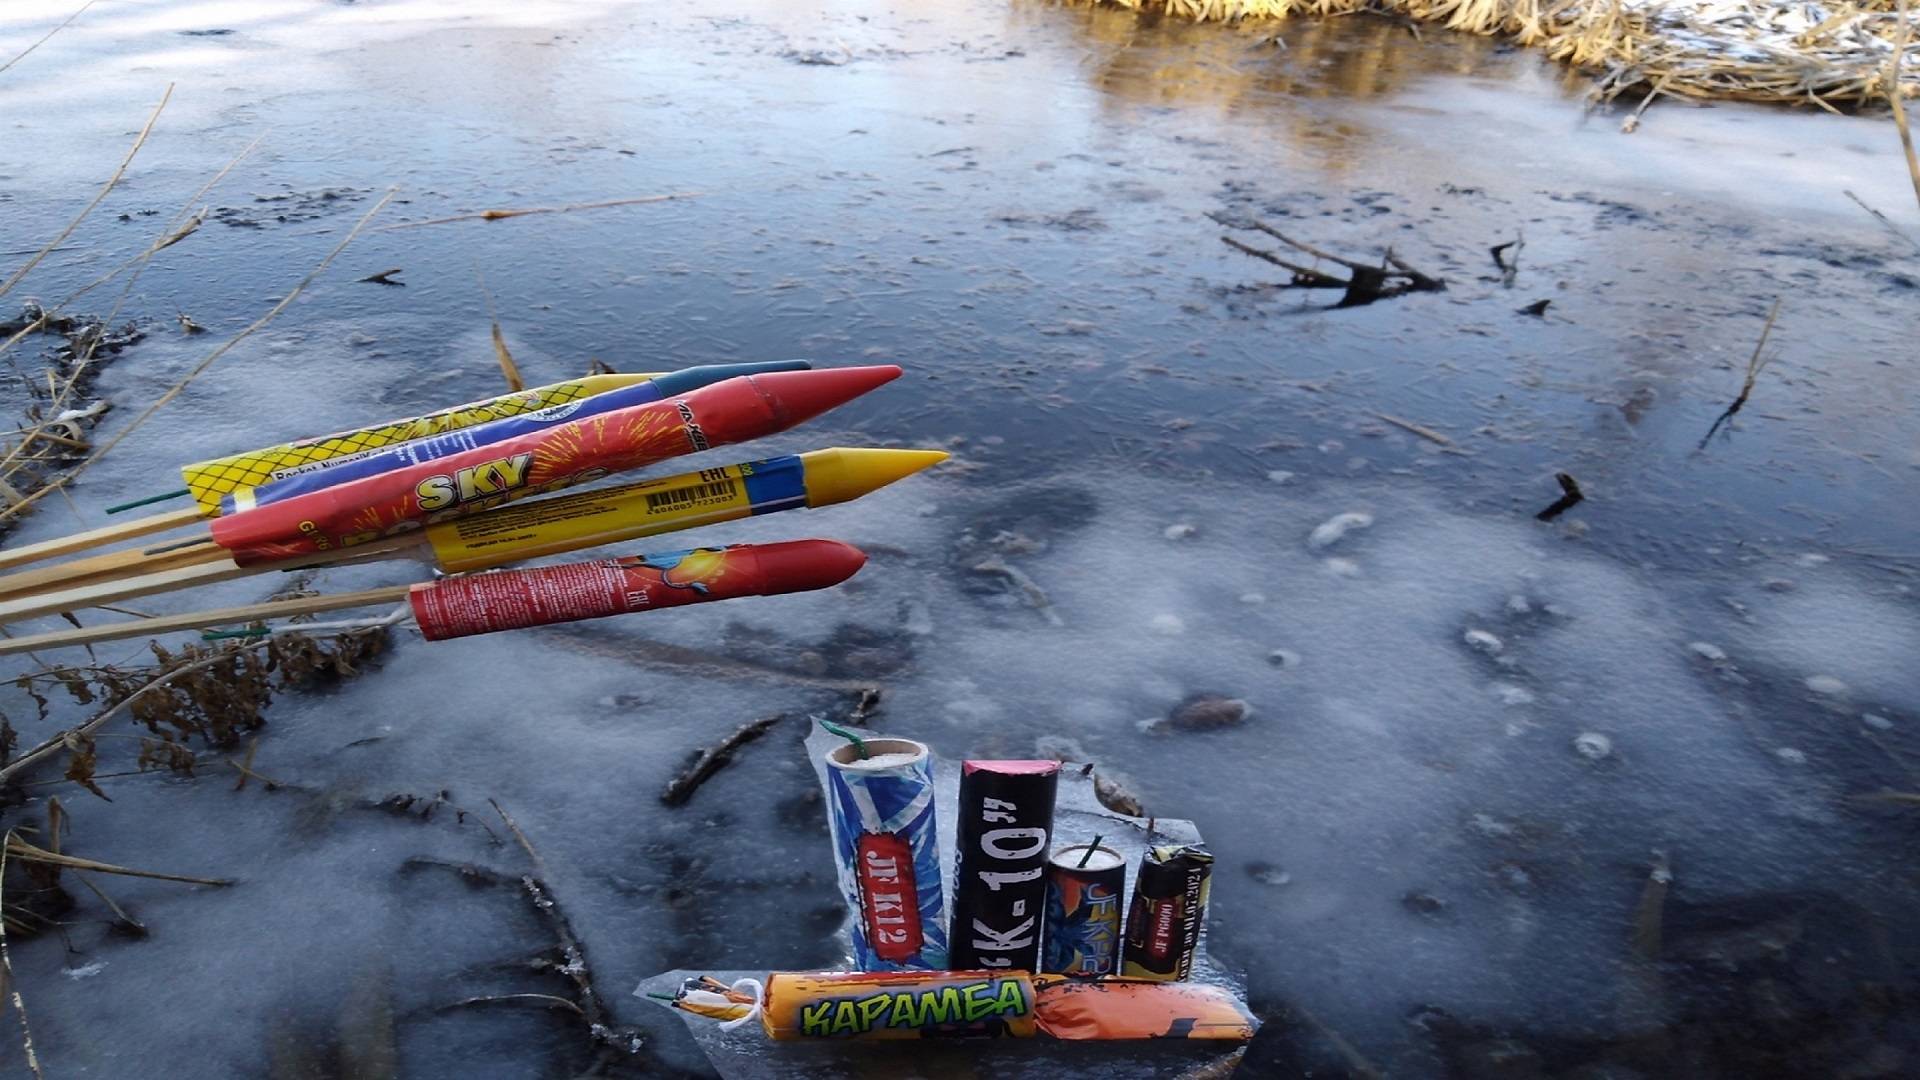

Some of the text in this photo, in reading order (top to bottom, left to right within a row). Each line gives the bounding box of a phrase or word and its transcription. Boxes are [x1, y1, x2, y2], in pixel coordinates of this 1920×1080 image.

[415, 452, 532, 512] SKY
[865, 850, 907, 944] JF K12
[1087, 882, 1117, 915] JF
[1183, 867, 1201, 931] 01.07.2024
[1154, 904, 1174, 953] JF P6000
[801, 979, 1026, 1037] КАРАМБА
